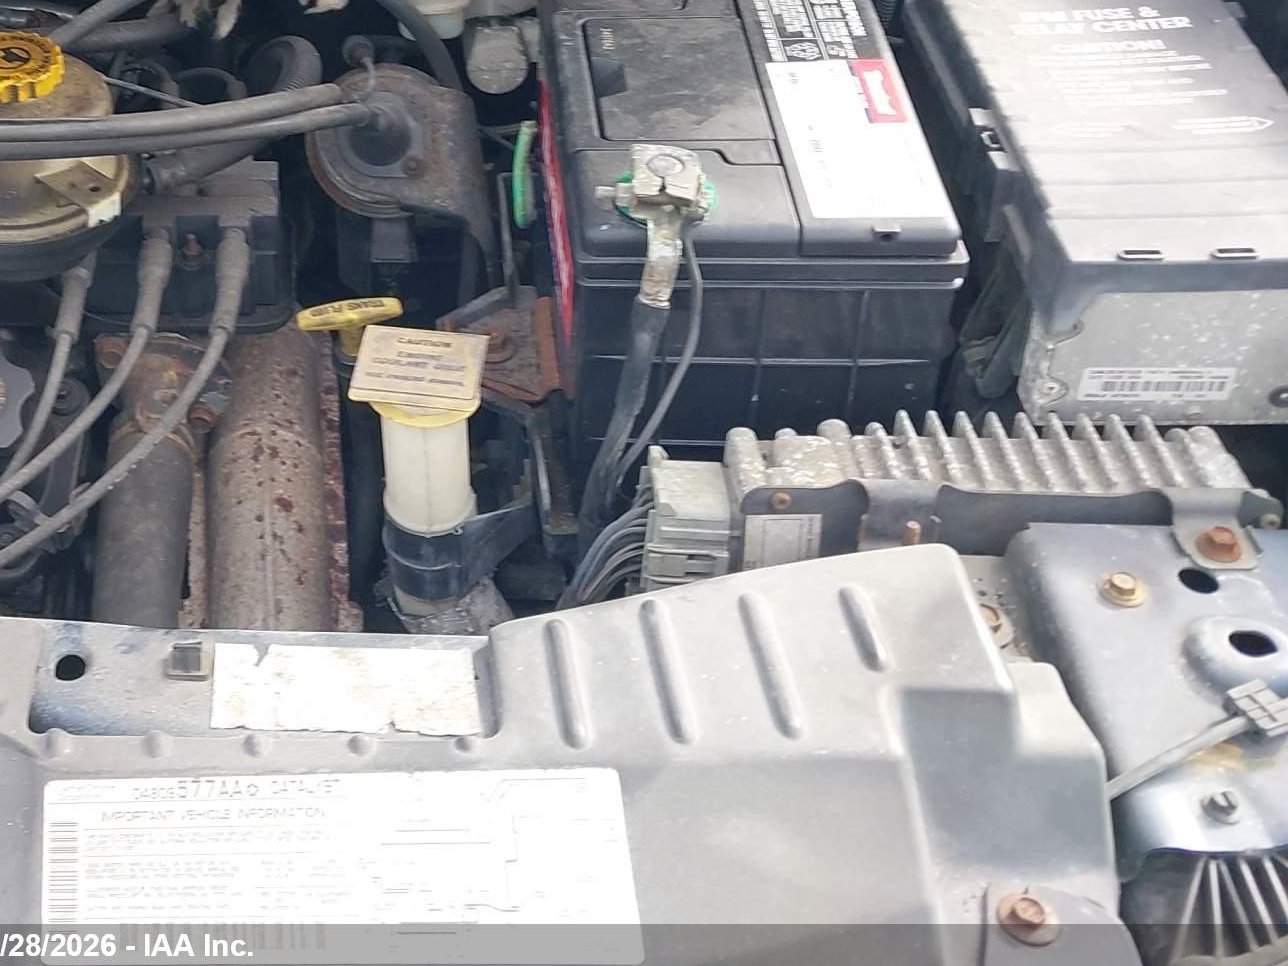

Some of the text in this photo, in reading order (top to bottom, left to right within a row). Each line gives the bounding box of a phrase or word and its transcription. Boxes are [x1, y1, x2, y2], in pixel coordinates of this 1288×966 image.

[1071, 7, 1134, 22] FUSE
[1137, 6, 1161, 19] &
[1090, 16, 1194, 33] CENTER
